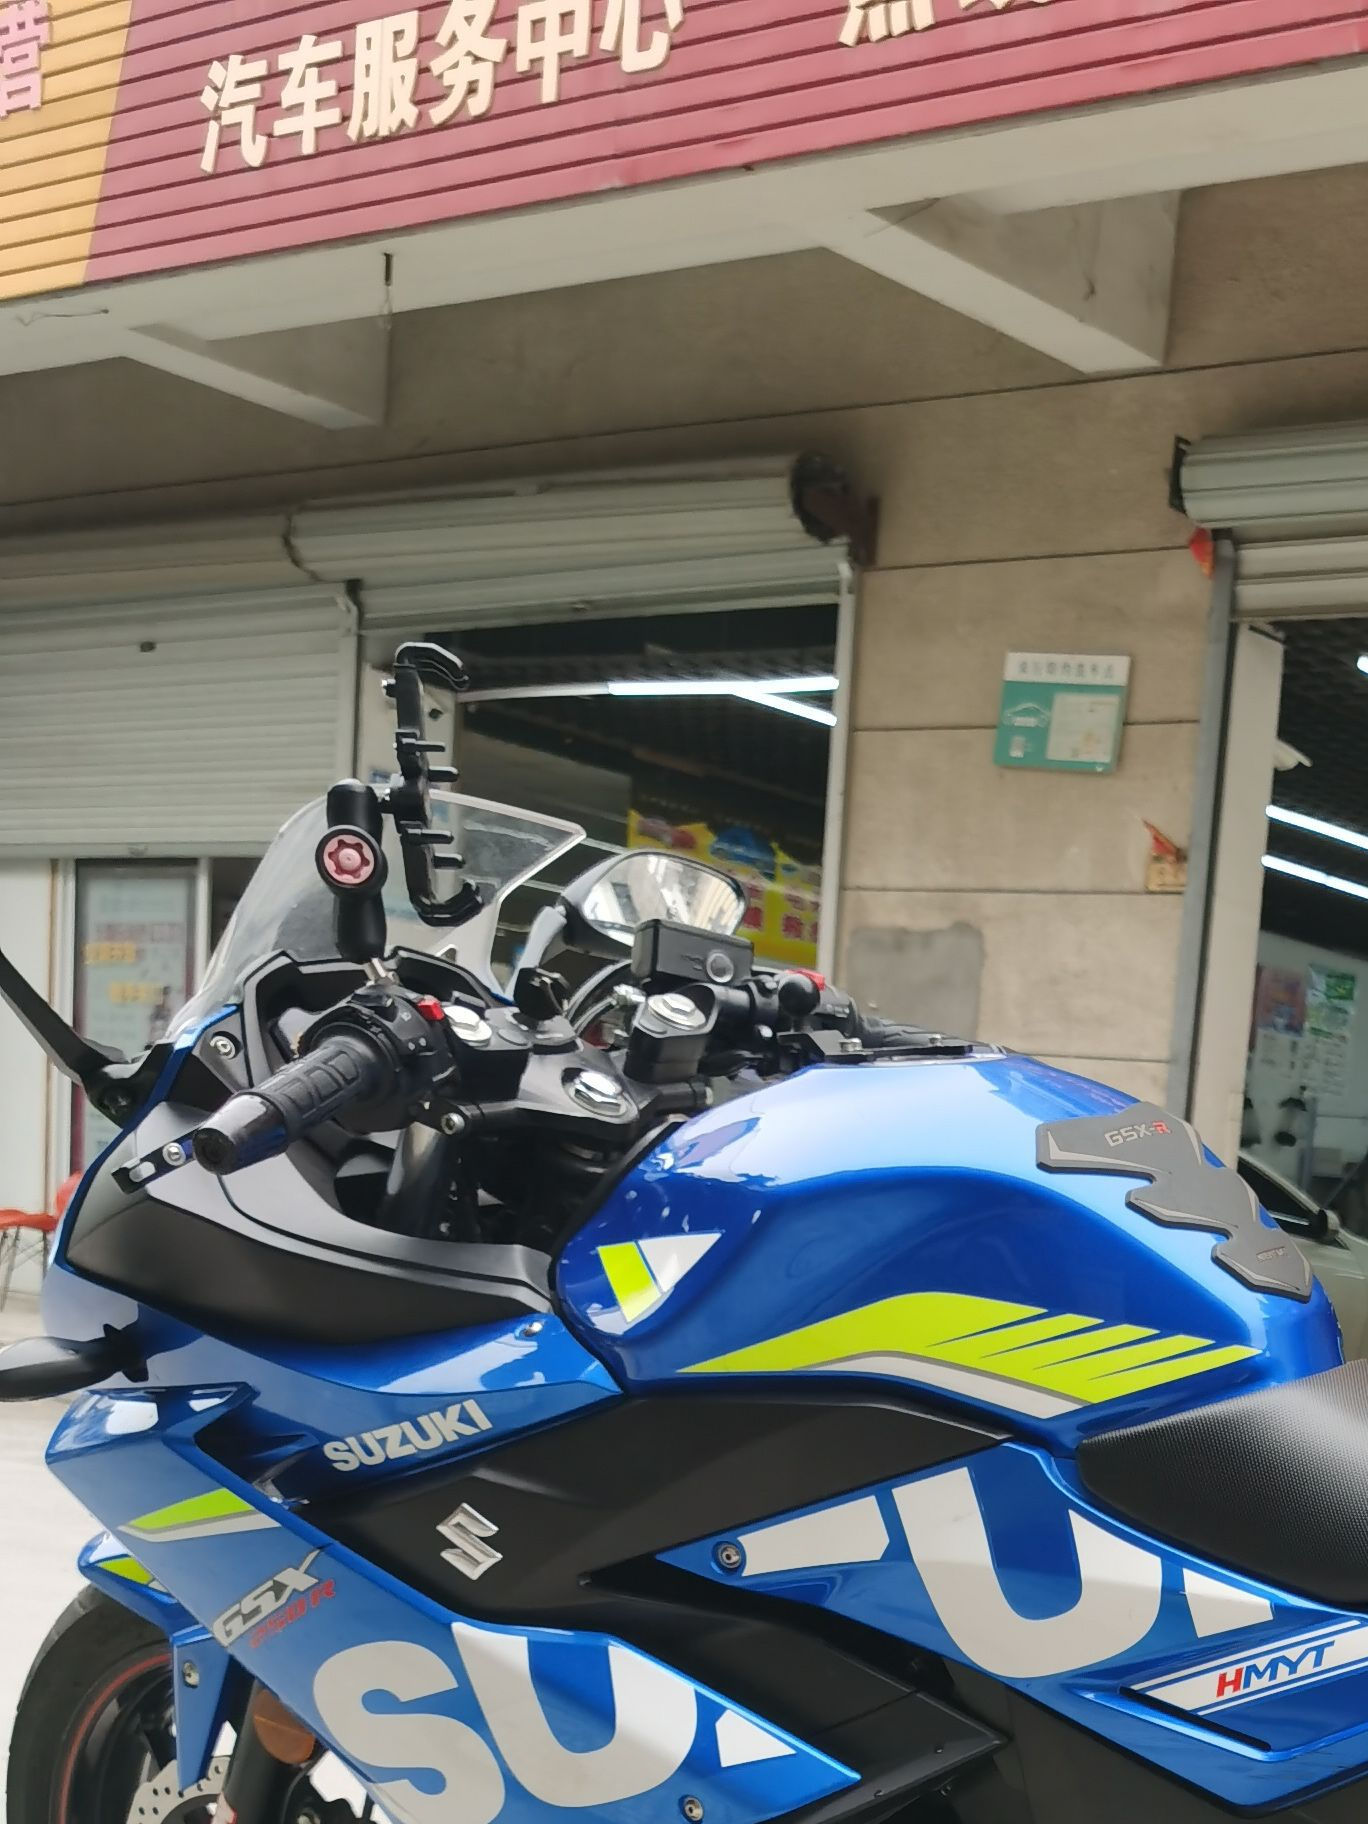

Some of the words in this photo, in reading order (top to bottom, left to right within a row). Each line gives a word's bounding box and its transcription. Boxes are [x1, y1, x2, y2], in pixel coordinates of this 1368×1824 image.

[201, 0, 684, 174] 汽车服务中心
[323, 1399, 493, 1472] SUZUKI
[213, 1549, 320, 1648] GSX
[1216, 1640, 1336, 1698] HMYT
